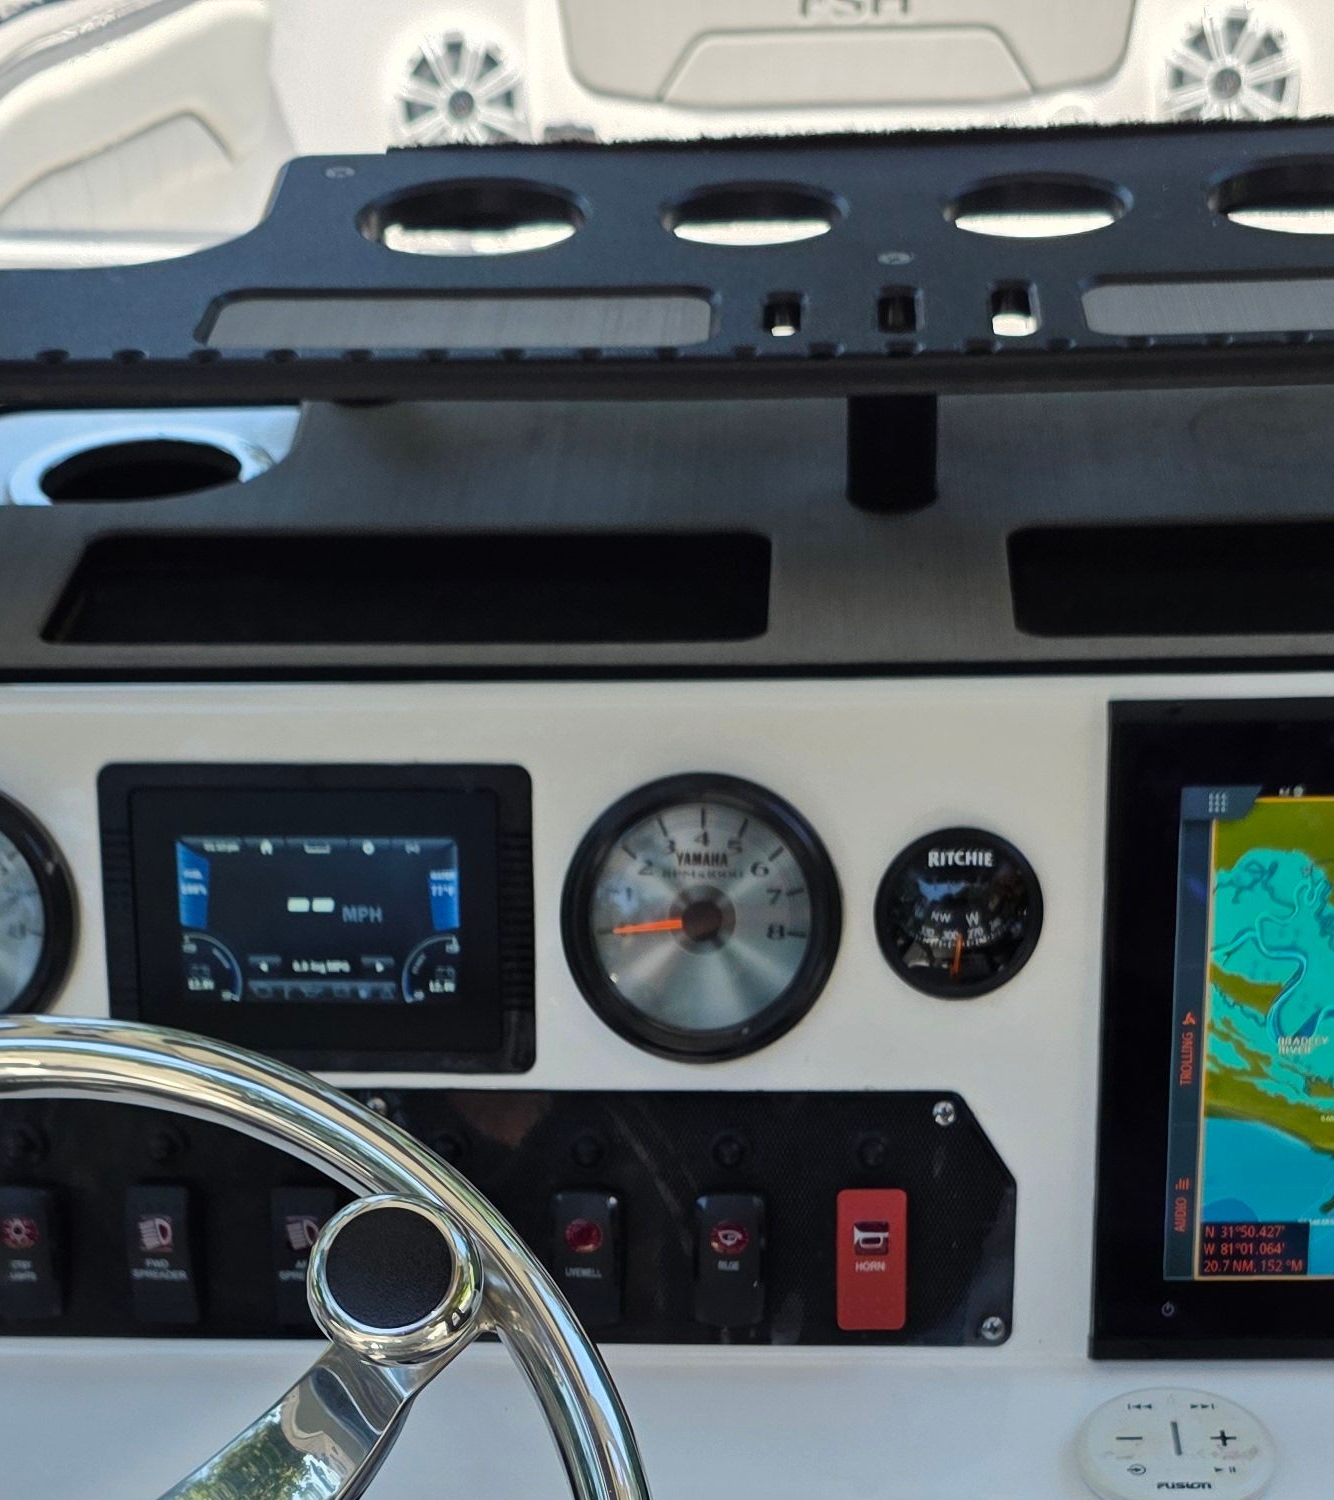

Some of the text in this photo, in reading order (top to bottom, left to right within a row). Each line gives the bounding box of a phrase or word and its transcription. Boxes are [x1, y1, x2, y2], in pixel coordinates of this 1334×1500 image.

[676, 852, 729, 868] YAMAHA
[928, 850, 994, 868] RITCHIE
[341, 906, 384, 924] MPH
[1180, 1032, 1194, 1086] TROLLING
[1174, 1197, 1187, 1233] AUDIO
[1204, 1226, 1215, 1239] N
[1203, 1243, 1216, 1256] W
[854, 1261, 887, 1272] HORN
[1203, 1260, 1230, 1273] 20.7
[1259, 1259, 1284, 1272] 152
